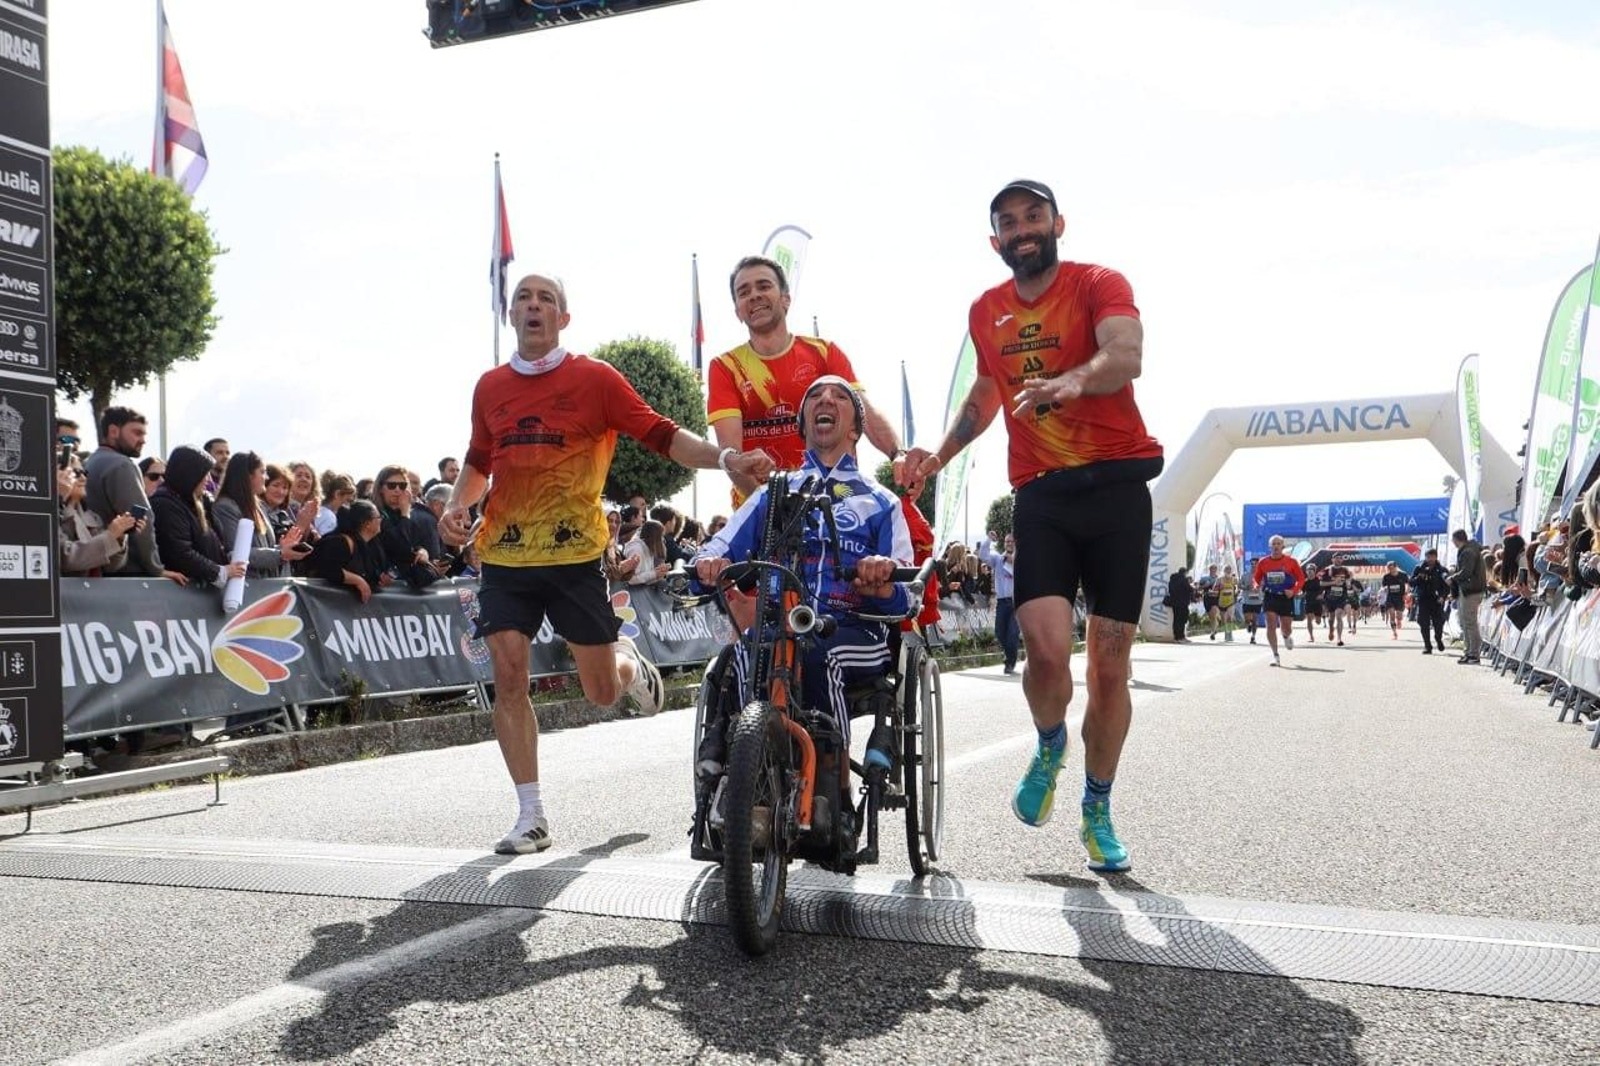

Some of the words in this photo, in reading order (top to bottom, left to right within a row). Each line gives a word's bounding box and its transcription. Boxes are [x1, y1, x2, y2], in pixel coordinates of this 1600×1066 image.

[769, 425, 781, 435] de
[1334, 504, 1386, 517] XUNTA
[1334, 518, 1355, 530] DE
[1357, 516, 1418, 529] GALICIA
[333, 614, 456, 663] MINIBAY
[133, 618, 214, 678] BAY
